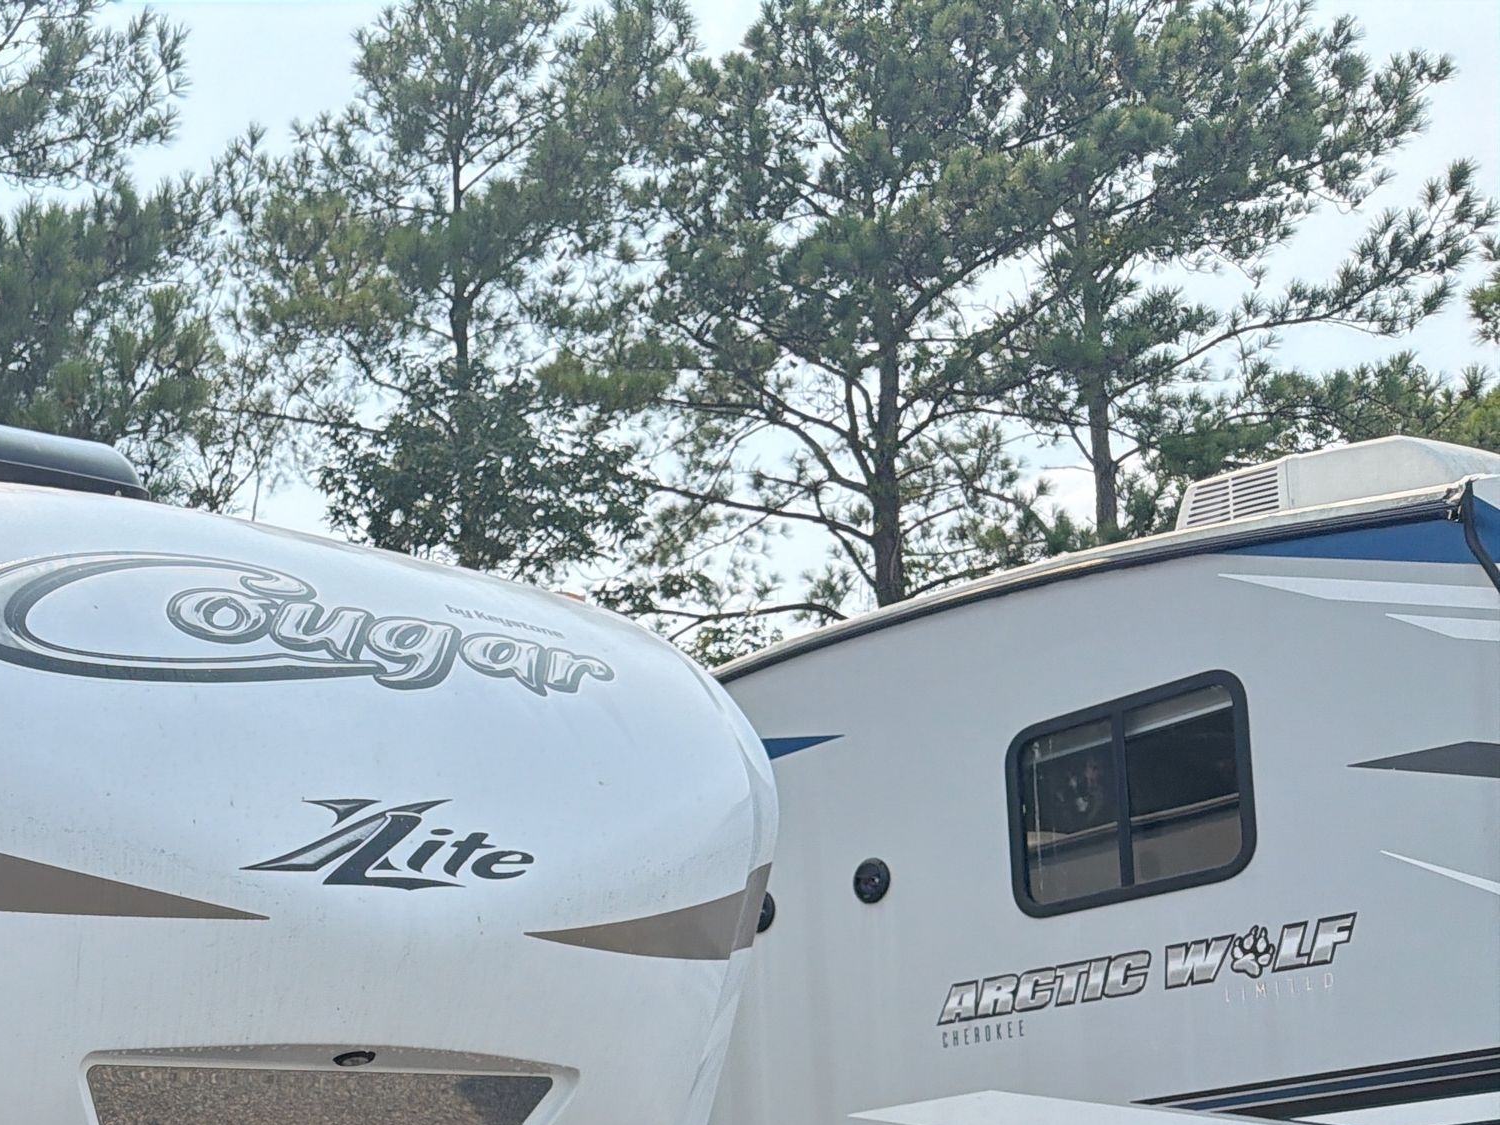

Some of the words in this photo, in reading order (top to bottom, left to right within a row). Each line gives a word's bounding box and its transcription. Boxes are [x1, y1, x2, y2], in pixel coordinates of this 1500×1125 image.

[444, 603, 474, 619] by
[937, 950, 1151, 1025] ARCTIC
[1165, 912, 1357, 989] WLF
[942, 1019, 1025, 1049] CHEROKEE
